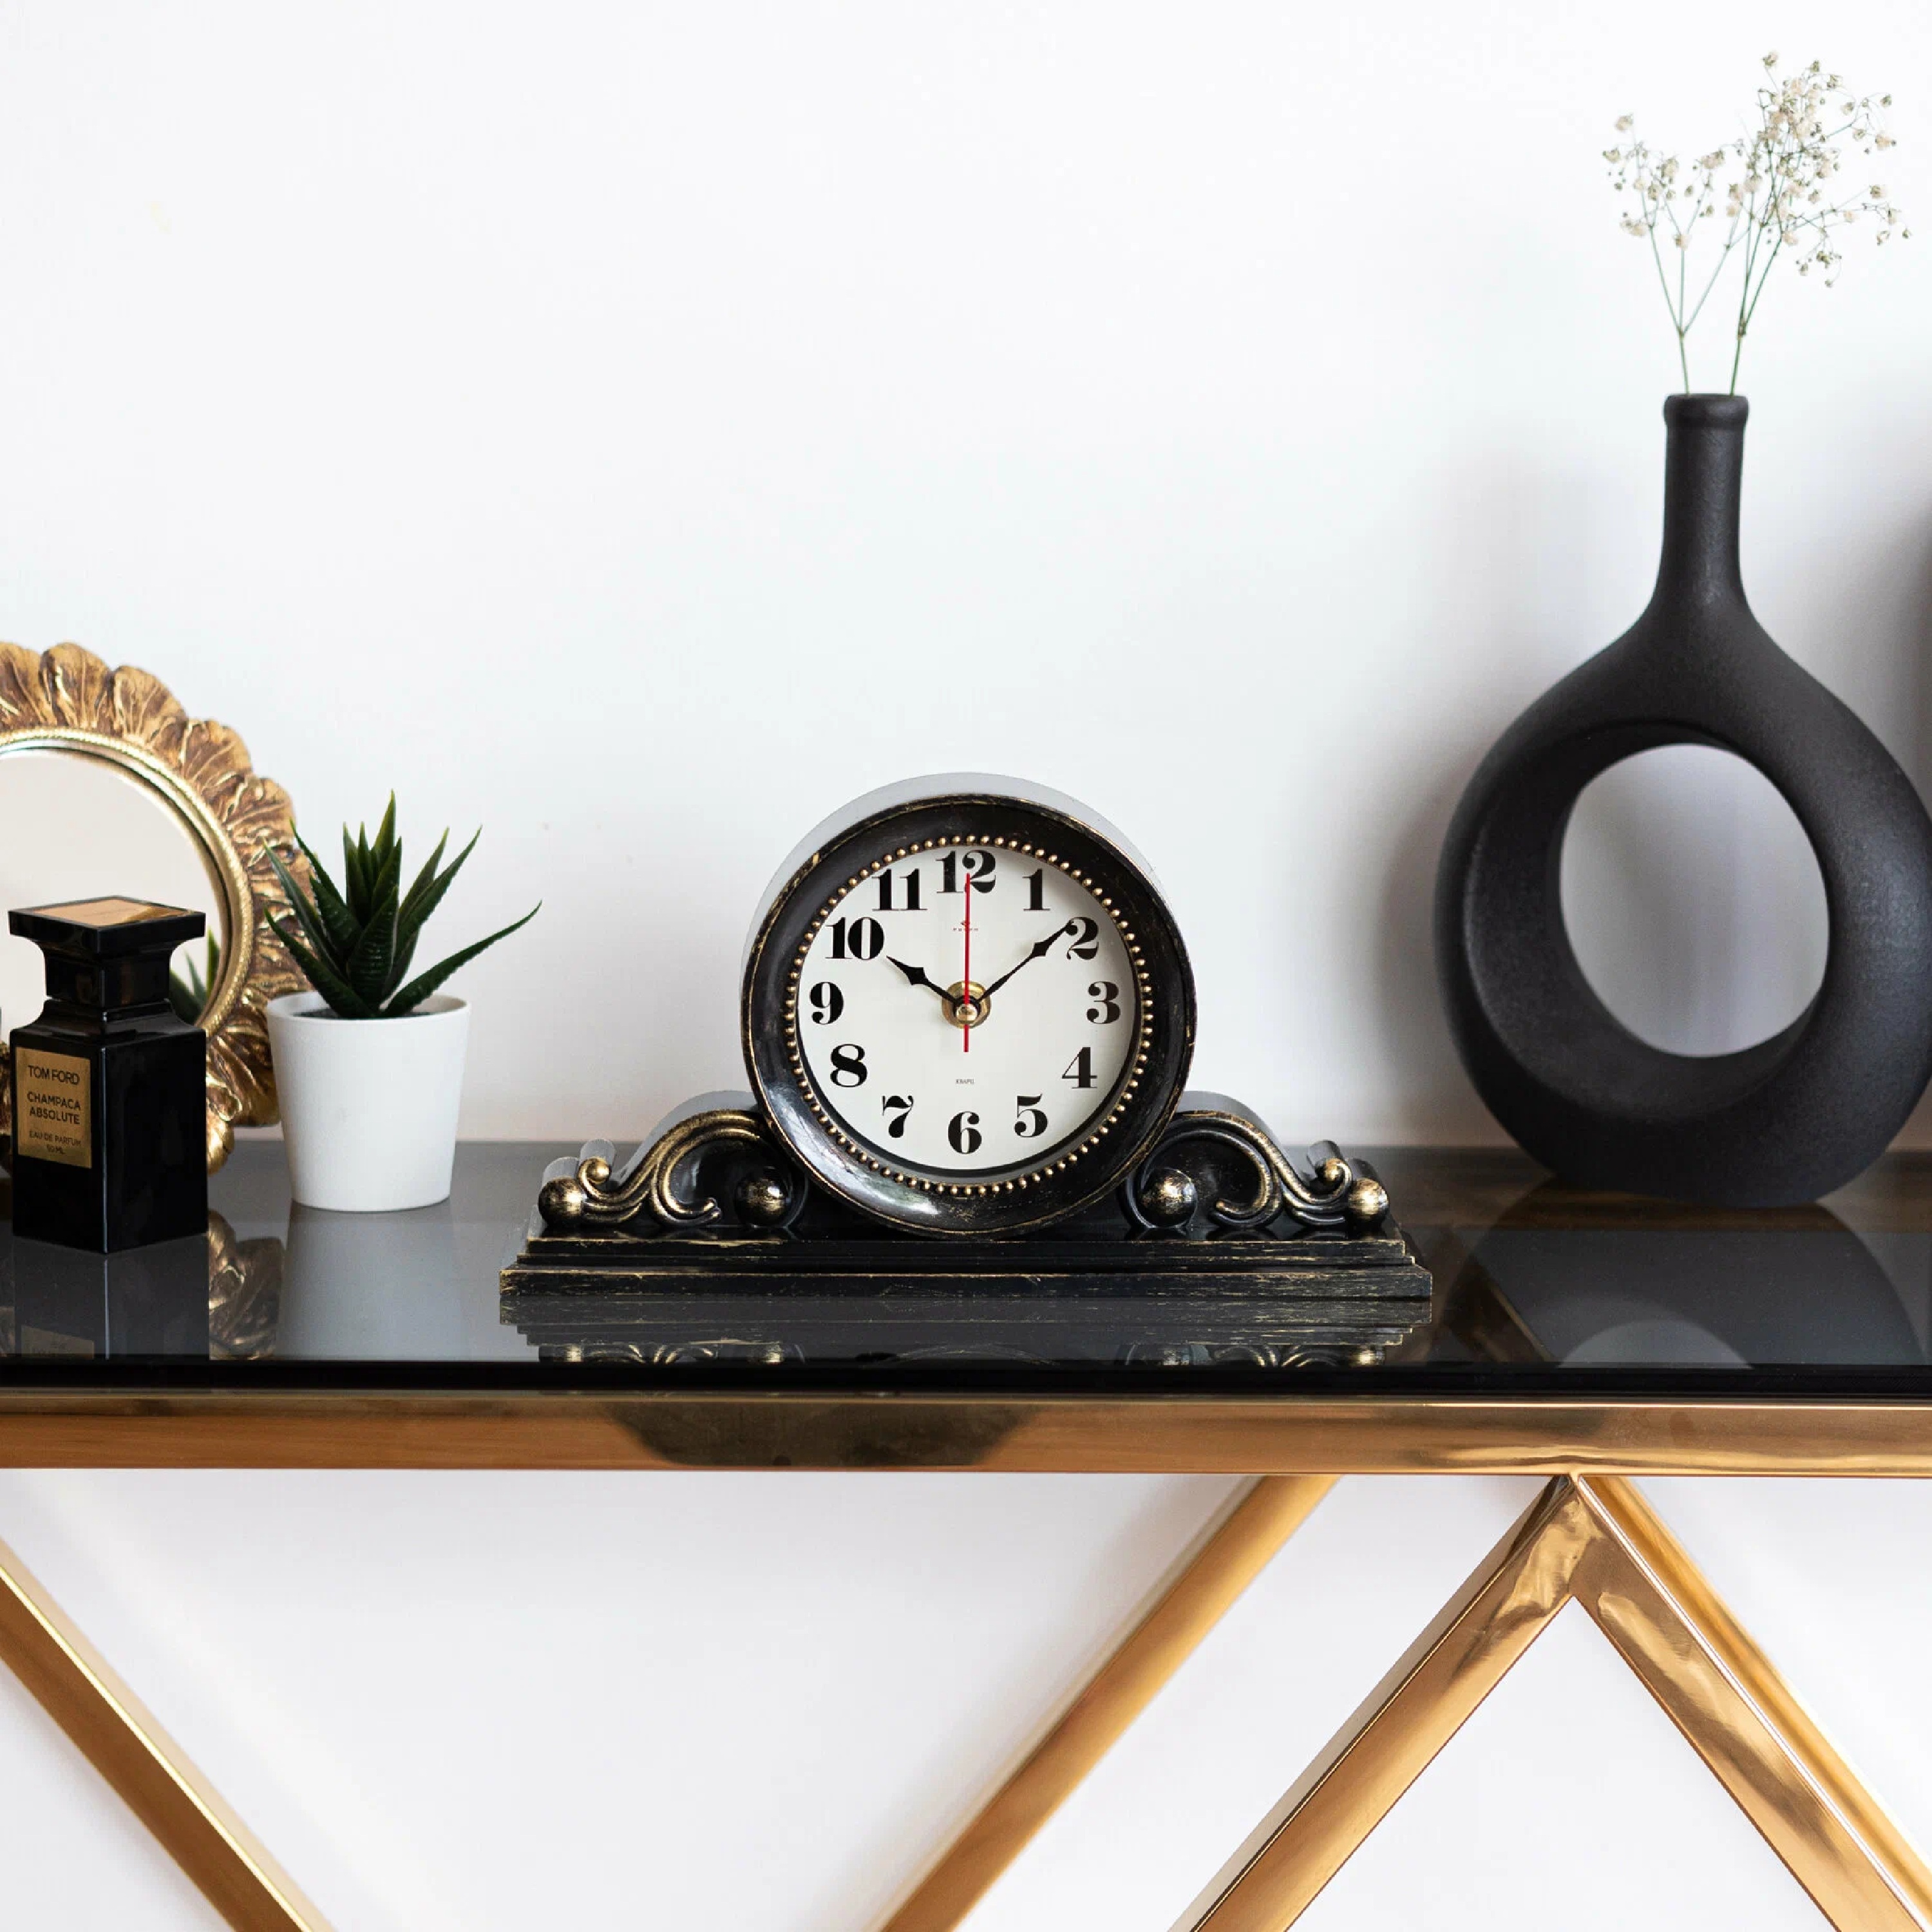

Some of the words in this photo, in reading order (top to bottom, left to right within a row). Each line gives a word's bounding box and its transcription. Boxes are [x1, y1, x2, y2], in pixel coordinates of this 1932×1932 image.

[872, 868, 927, 911] 11
[936, 849, 996, 894] 12
[1023, 868, 1051, 911] 1
[825, 916, 885, 960] 10
[1066, 916, 1099, 960] 2
[809, 981, 844, 1025] 9
[1086, 981, 1121, 1025] 3
[28, 1065, 50, 1079] TOM
[52, 1069, 80, 1085] FORD
[829, 1044, 868, 1088] 8
[1061, 1046, 1097, 1089] 4
[26, 1091, 81, 1110] CHAMPACA
[29, 1106, 80, 1124] ABSOLUTE
[882, 1095, 914, 1138] 7
[1014, 1094, 1048, 1137] 5
[29, 1130, 43, 1139] EAU
[44, 1133, 53, 1142] DE
[54, 1135, 81, 1147] PARFUM
[948, 1111, 982, 1154] 6
